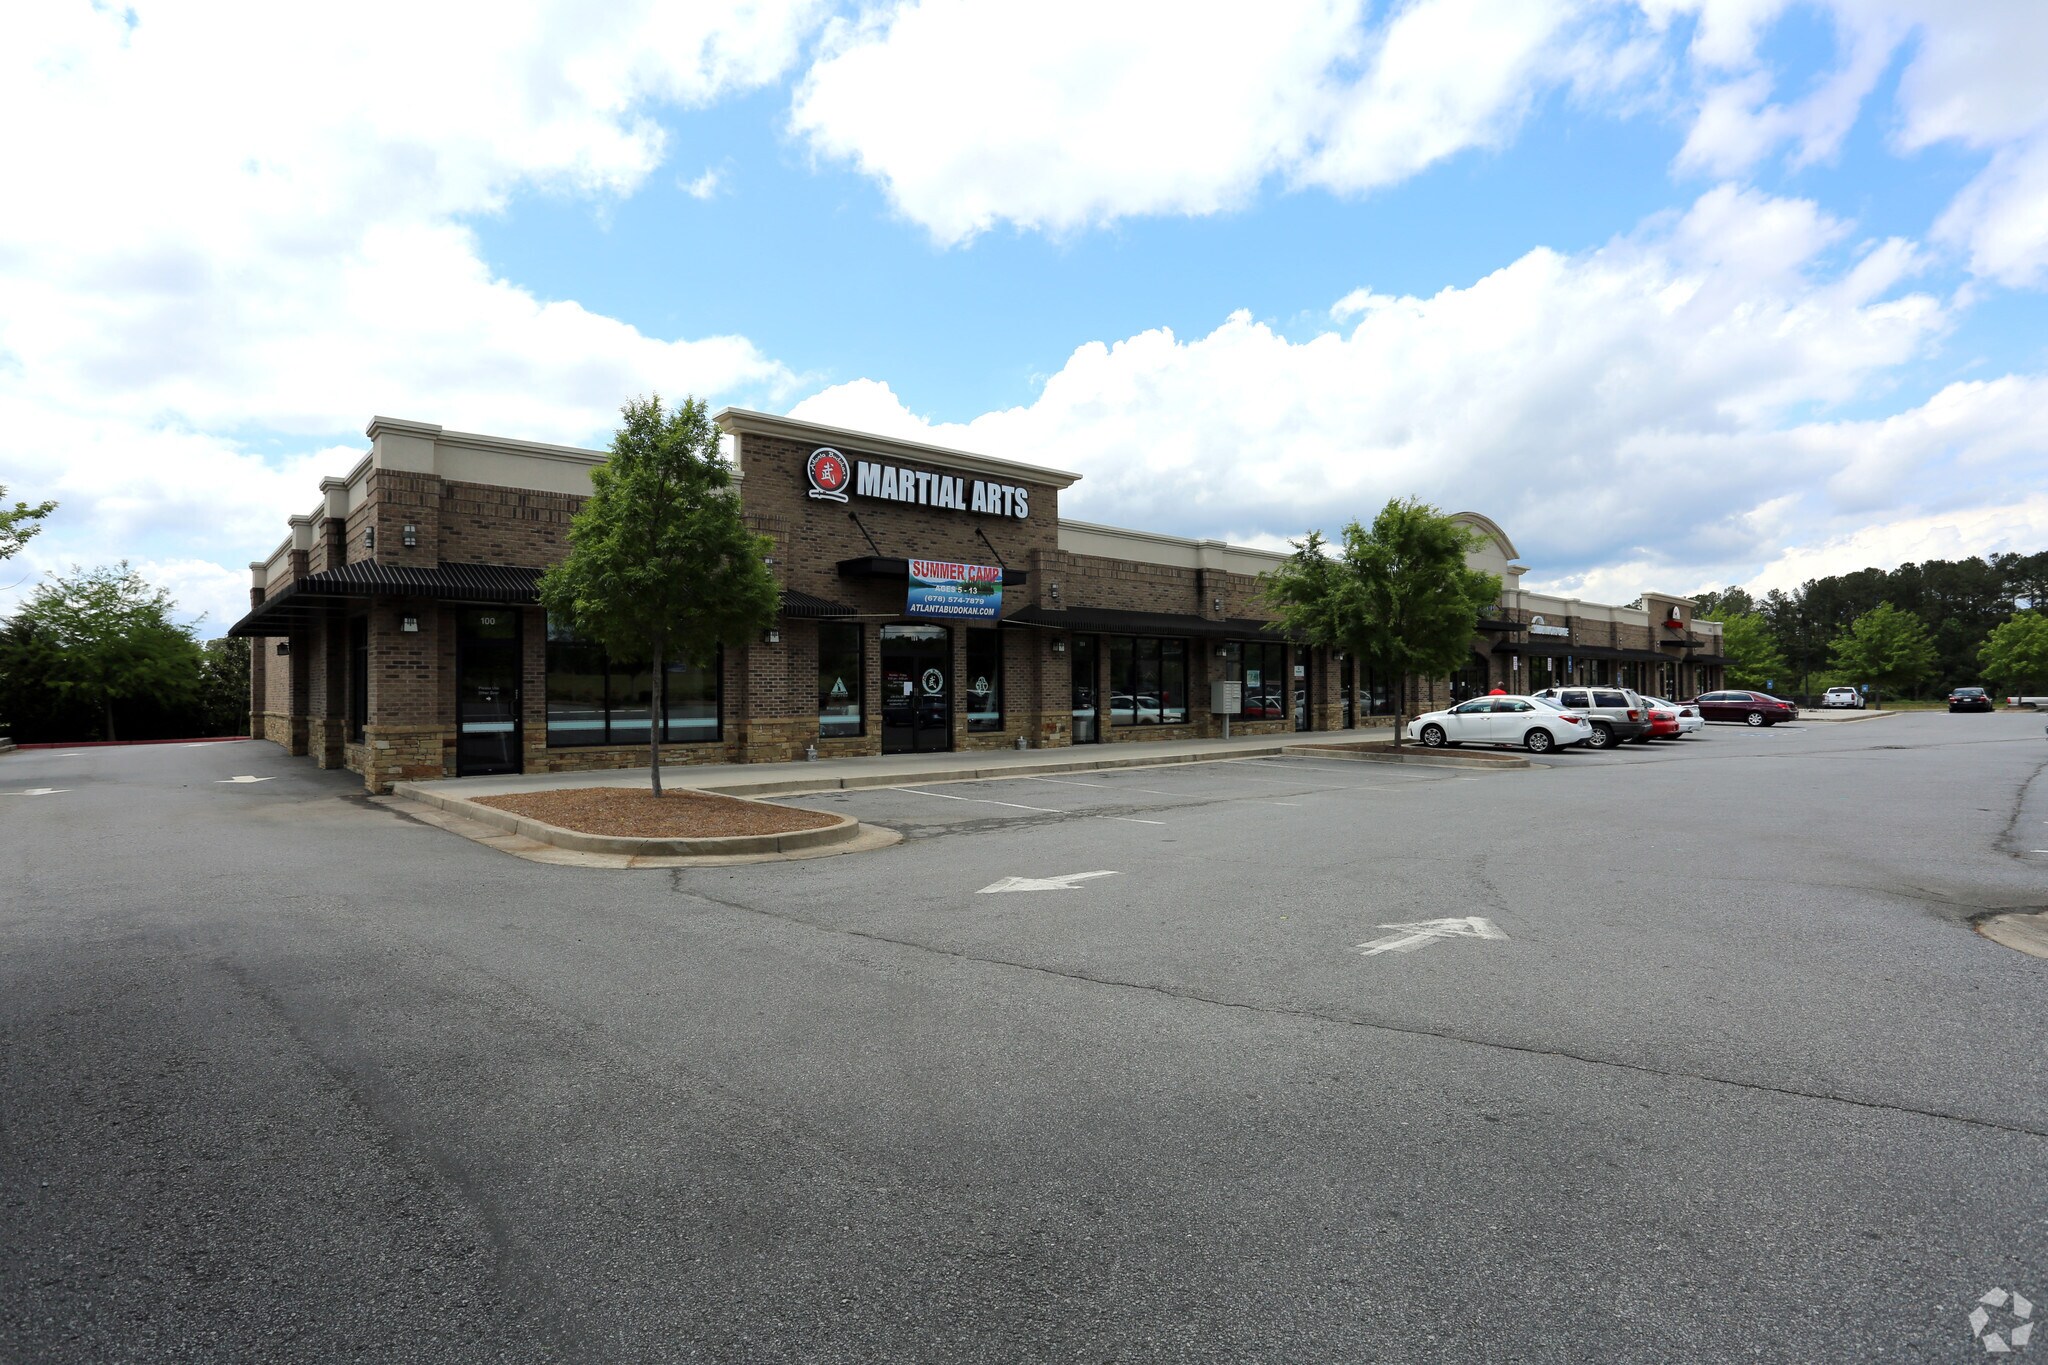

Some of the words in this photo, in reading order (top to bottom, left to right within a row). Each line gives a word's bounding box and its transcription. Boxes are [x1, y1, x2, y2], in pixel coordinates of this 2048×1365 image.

[820, 461, 836, 485] 武
[857, 461, 966, 510] MARTIAL
[971, 479, 1029, 519] ARTS
[913, 561, 964, 580] SUMMER
[968, 566, 999, 582] CAMP
[968, 587, 978, 595] 13
[910, 604, 994, 615] ATLANTABUDOKAN.COM
[480, 617, 496, 625] 100
